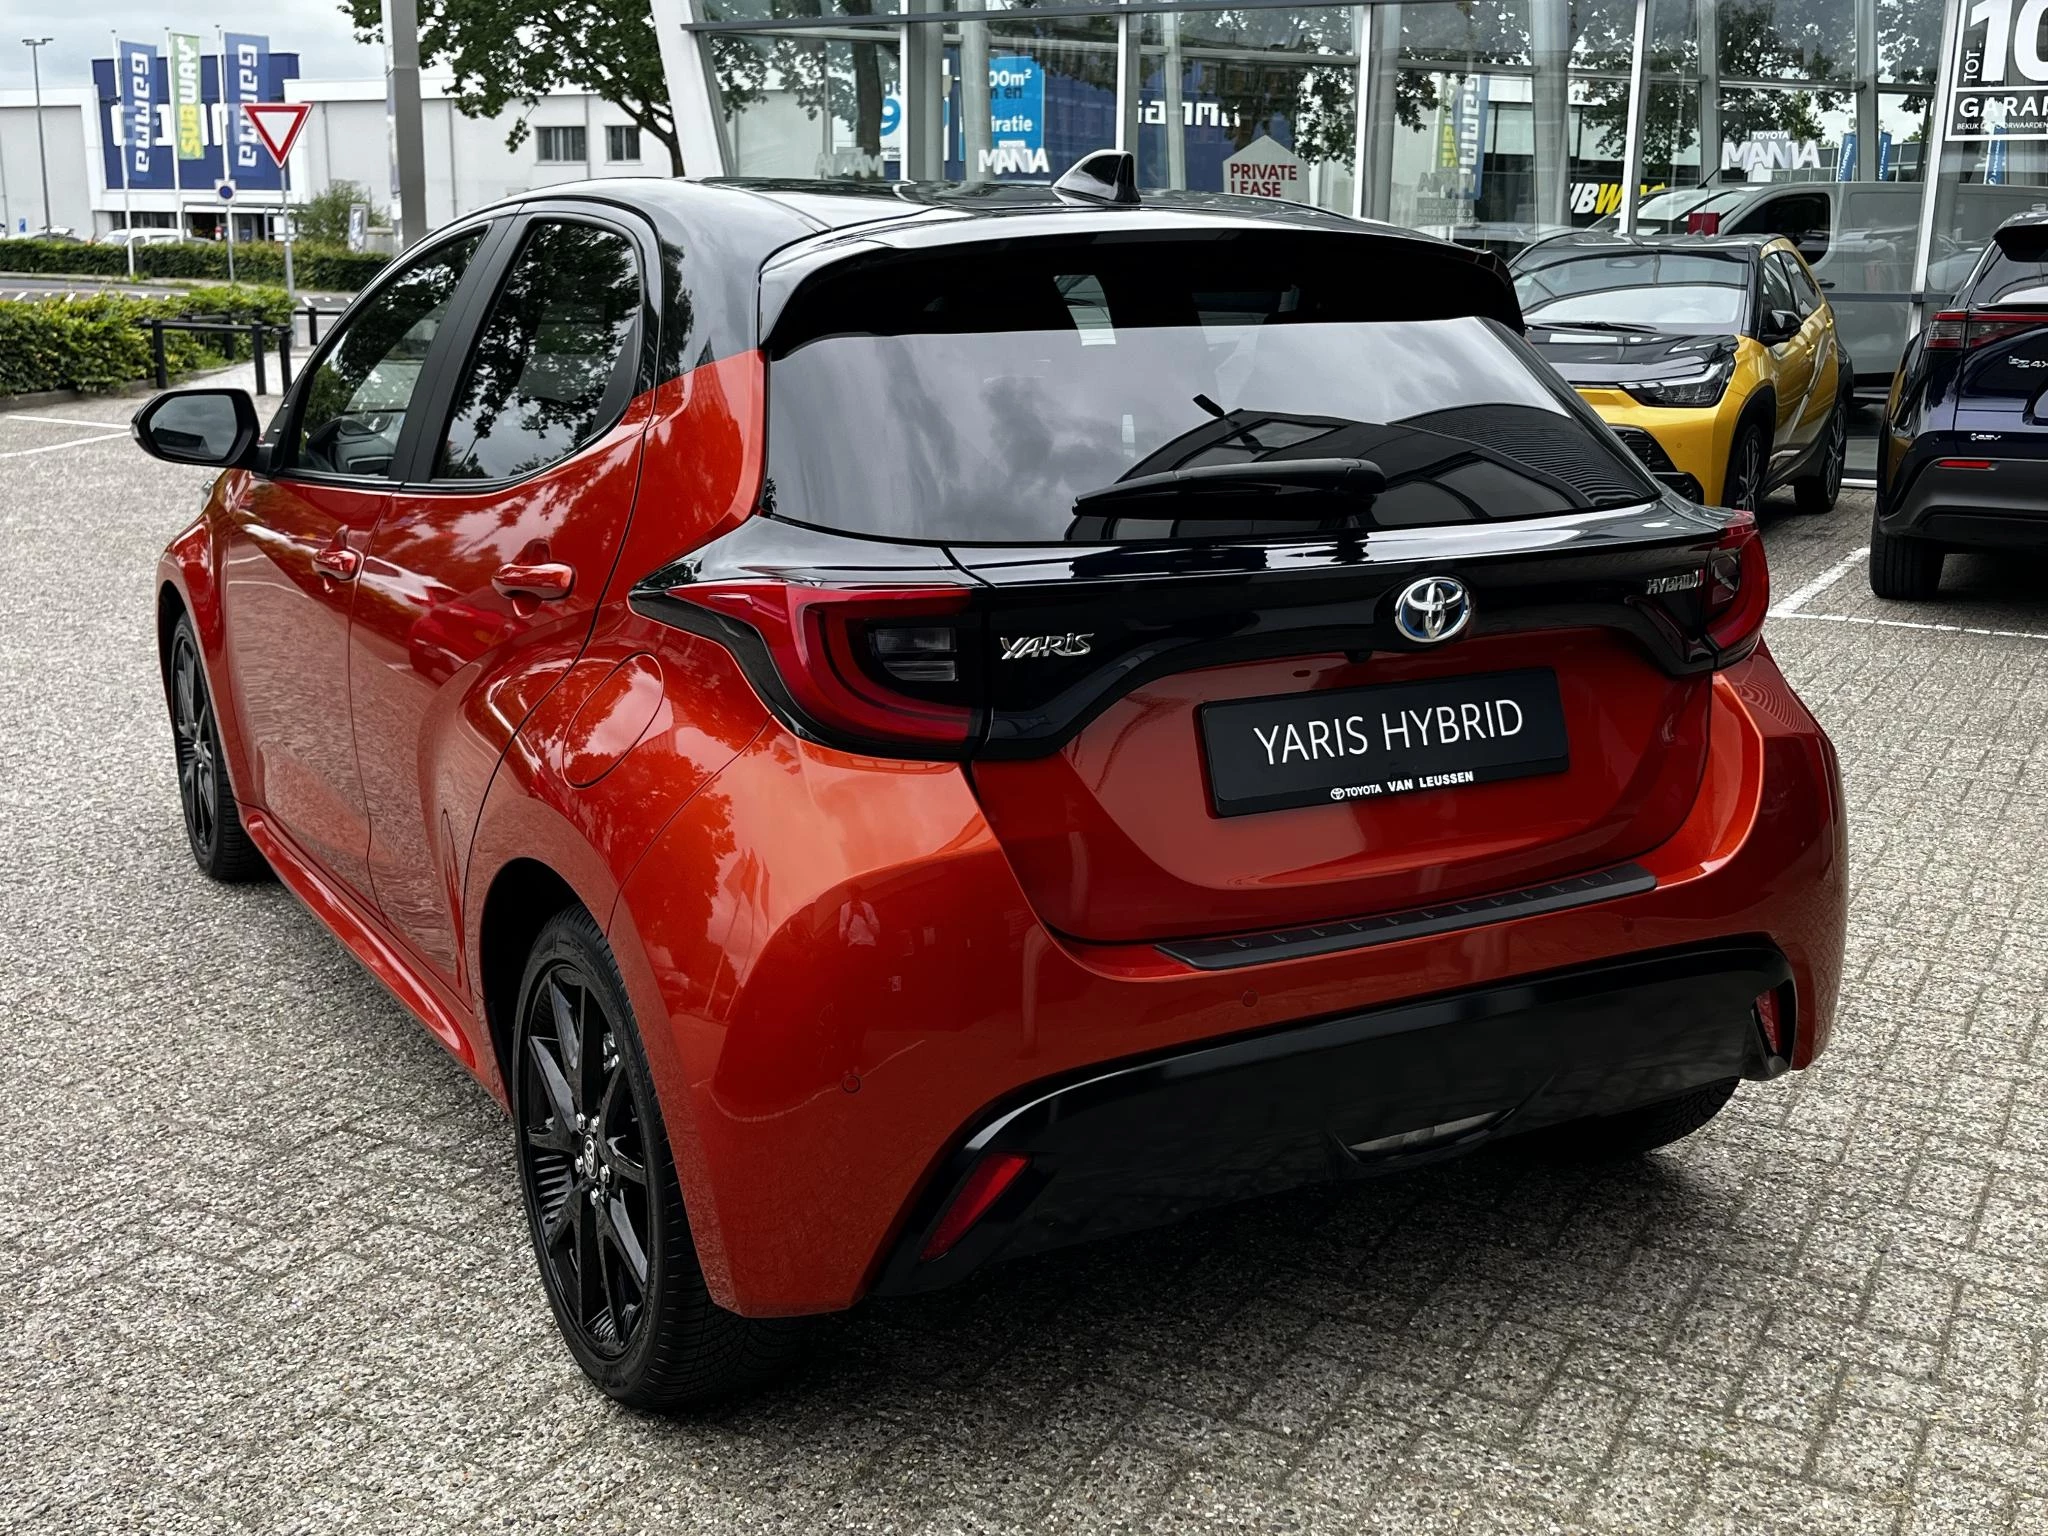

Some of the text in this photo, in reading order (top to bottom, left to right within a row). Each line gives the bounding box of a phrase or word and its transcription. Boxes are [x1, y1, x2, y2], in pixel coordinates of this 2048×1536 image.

[1963, 50, 1983, 82] TOT
[177, 36, 202, 158] SUBWAY
[1752, 131, 1790, 140] TOYOTA
[978, 147, 1050, 175] MANIA
[1721, 140, 1821, 172] MANIA
[1230, 163, 1297, 181] PRIVATE
[1647, 571, 1698, 595] HYBRID
[1253, 699, 1523, 765] YARIS HYBRID
[1345, 771, 1474, 797] TOYOTA VAN LEUSSEN
